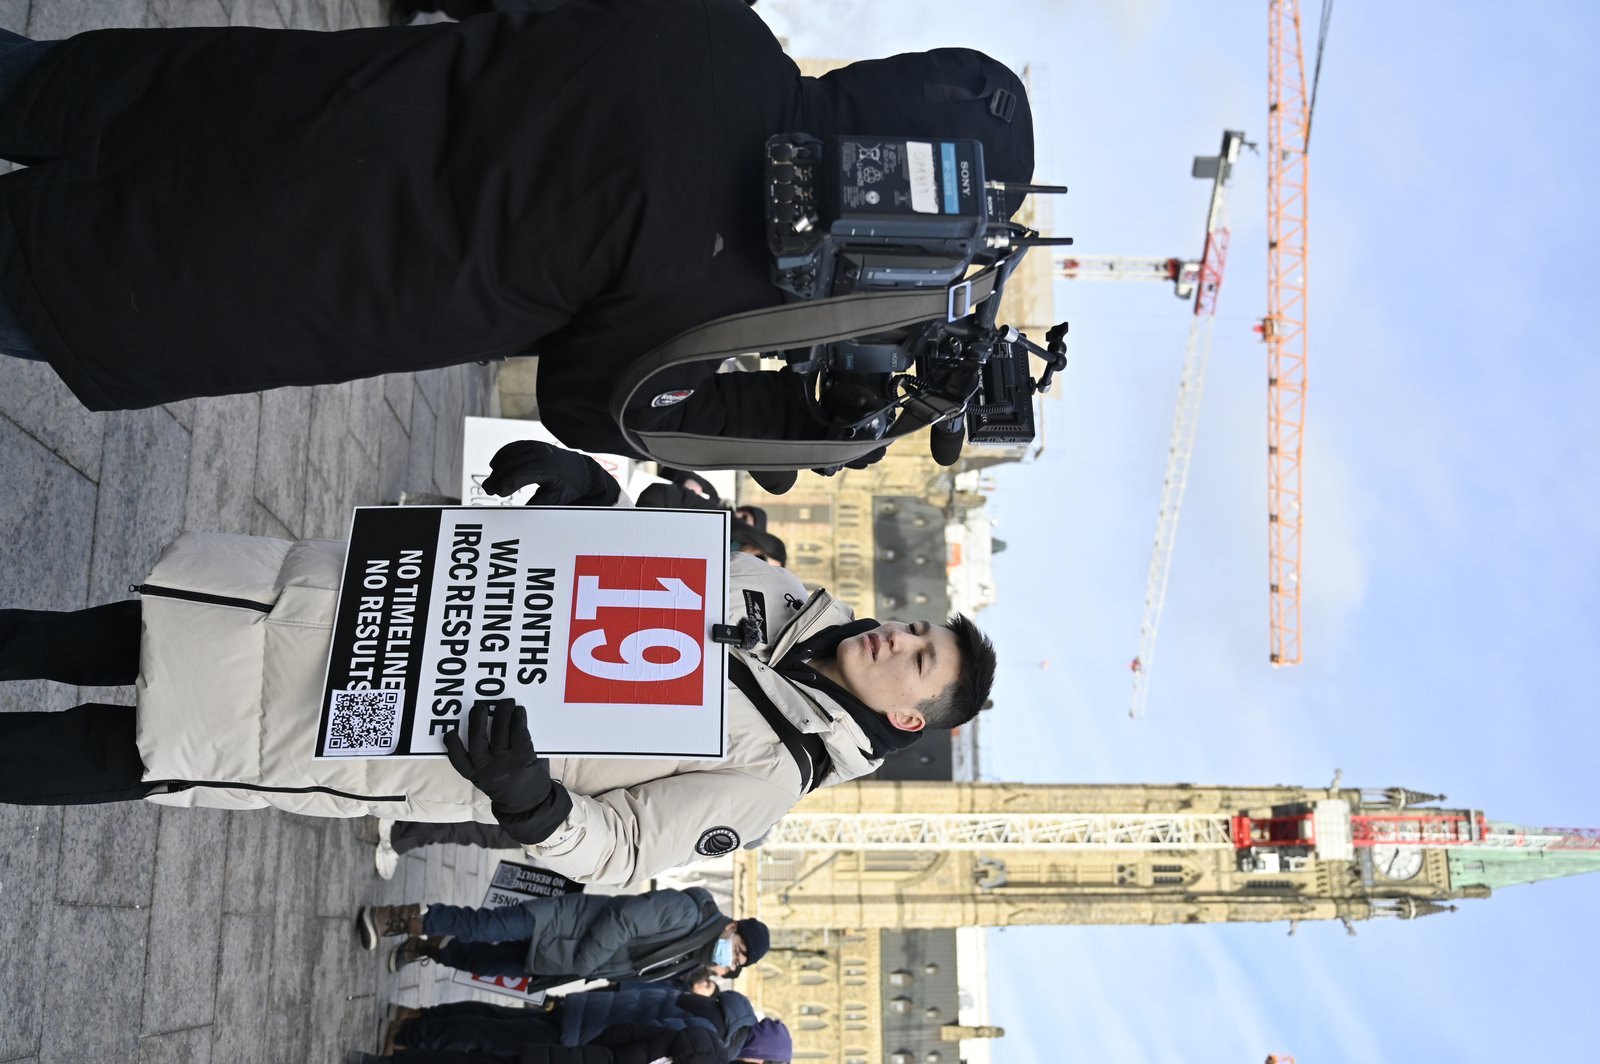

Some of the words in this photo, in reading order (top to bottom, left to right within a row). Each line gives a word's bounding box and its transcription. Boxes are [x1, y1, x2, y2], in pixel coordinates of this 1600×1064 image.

[960, 161, 970, 196] SONY
[362, 559, 390, 590] NO
[396, 550, 423, 580] NO
[448, 523, 483, 581] IRCC
[479, 538, 520, 652] WAITING
[346, 596, 385, 691] RESULTS
[380, 584, 419, 690] TIMELINE
[517, 568, 556, 685] MONTHS
[570, 575, 703, 682] 19
[428, 585, 476, 736] RESPONSE
[474, 662, 507, 707] FO
[512, 880, 551, 896] TIMELINE
[552, 878, 566, 888] NO
